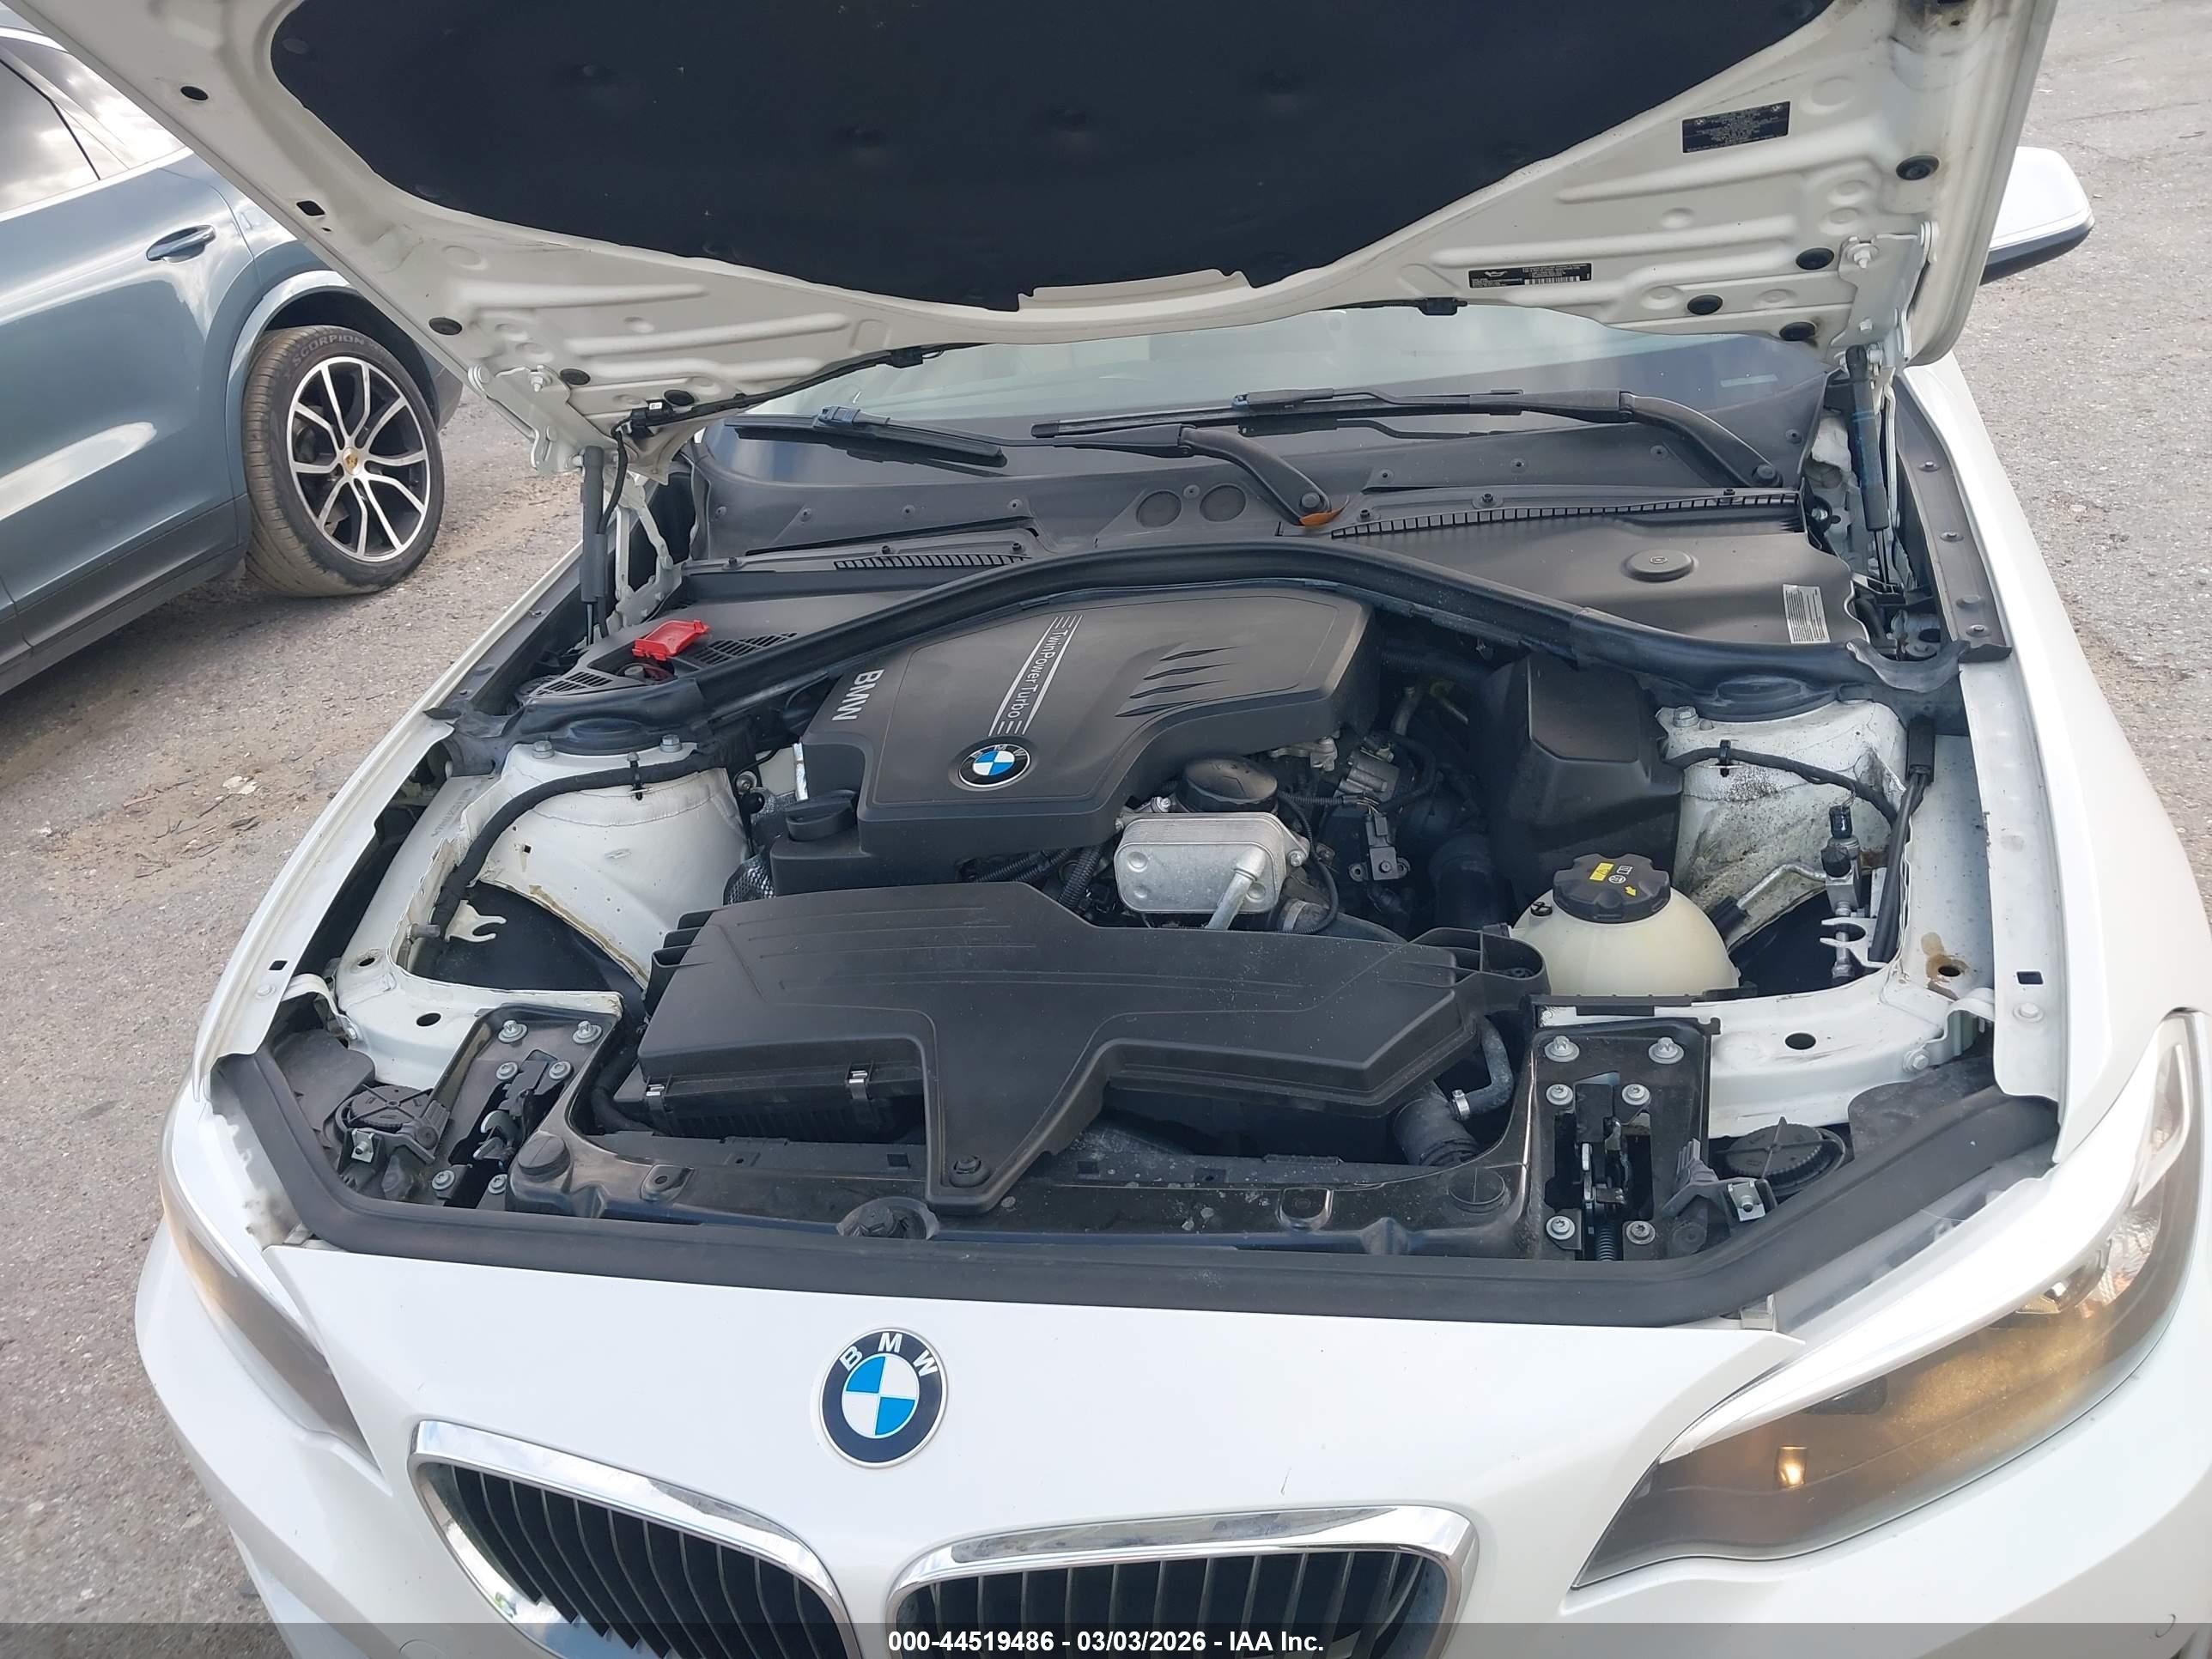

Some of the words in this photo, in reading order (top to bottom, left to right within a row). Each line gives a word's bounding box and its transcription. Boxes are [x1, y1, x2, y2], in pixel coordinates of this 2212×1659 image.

[292, 334, 365, 367] SCORPION
[831, 669, 885, 721] BMW
[839, 1333, 939, 1377] BMW
